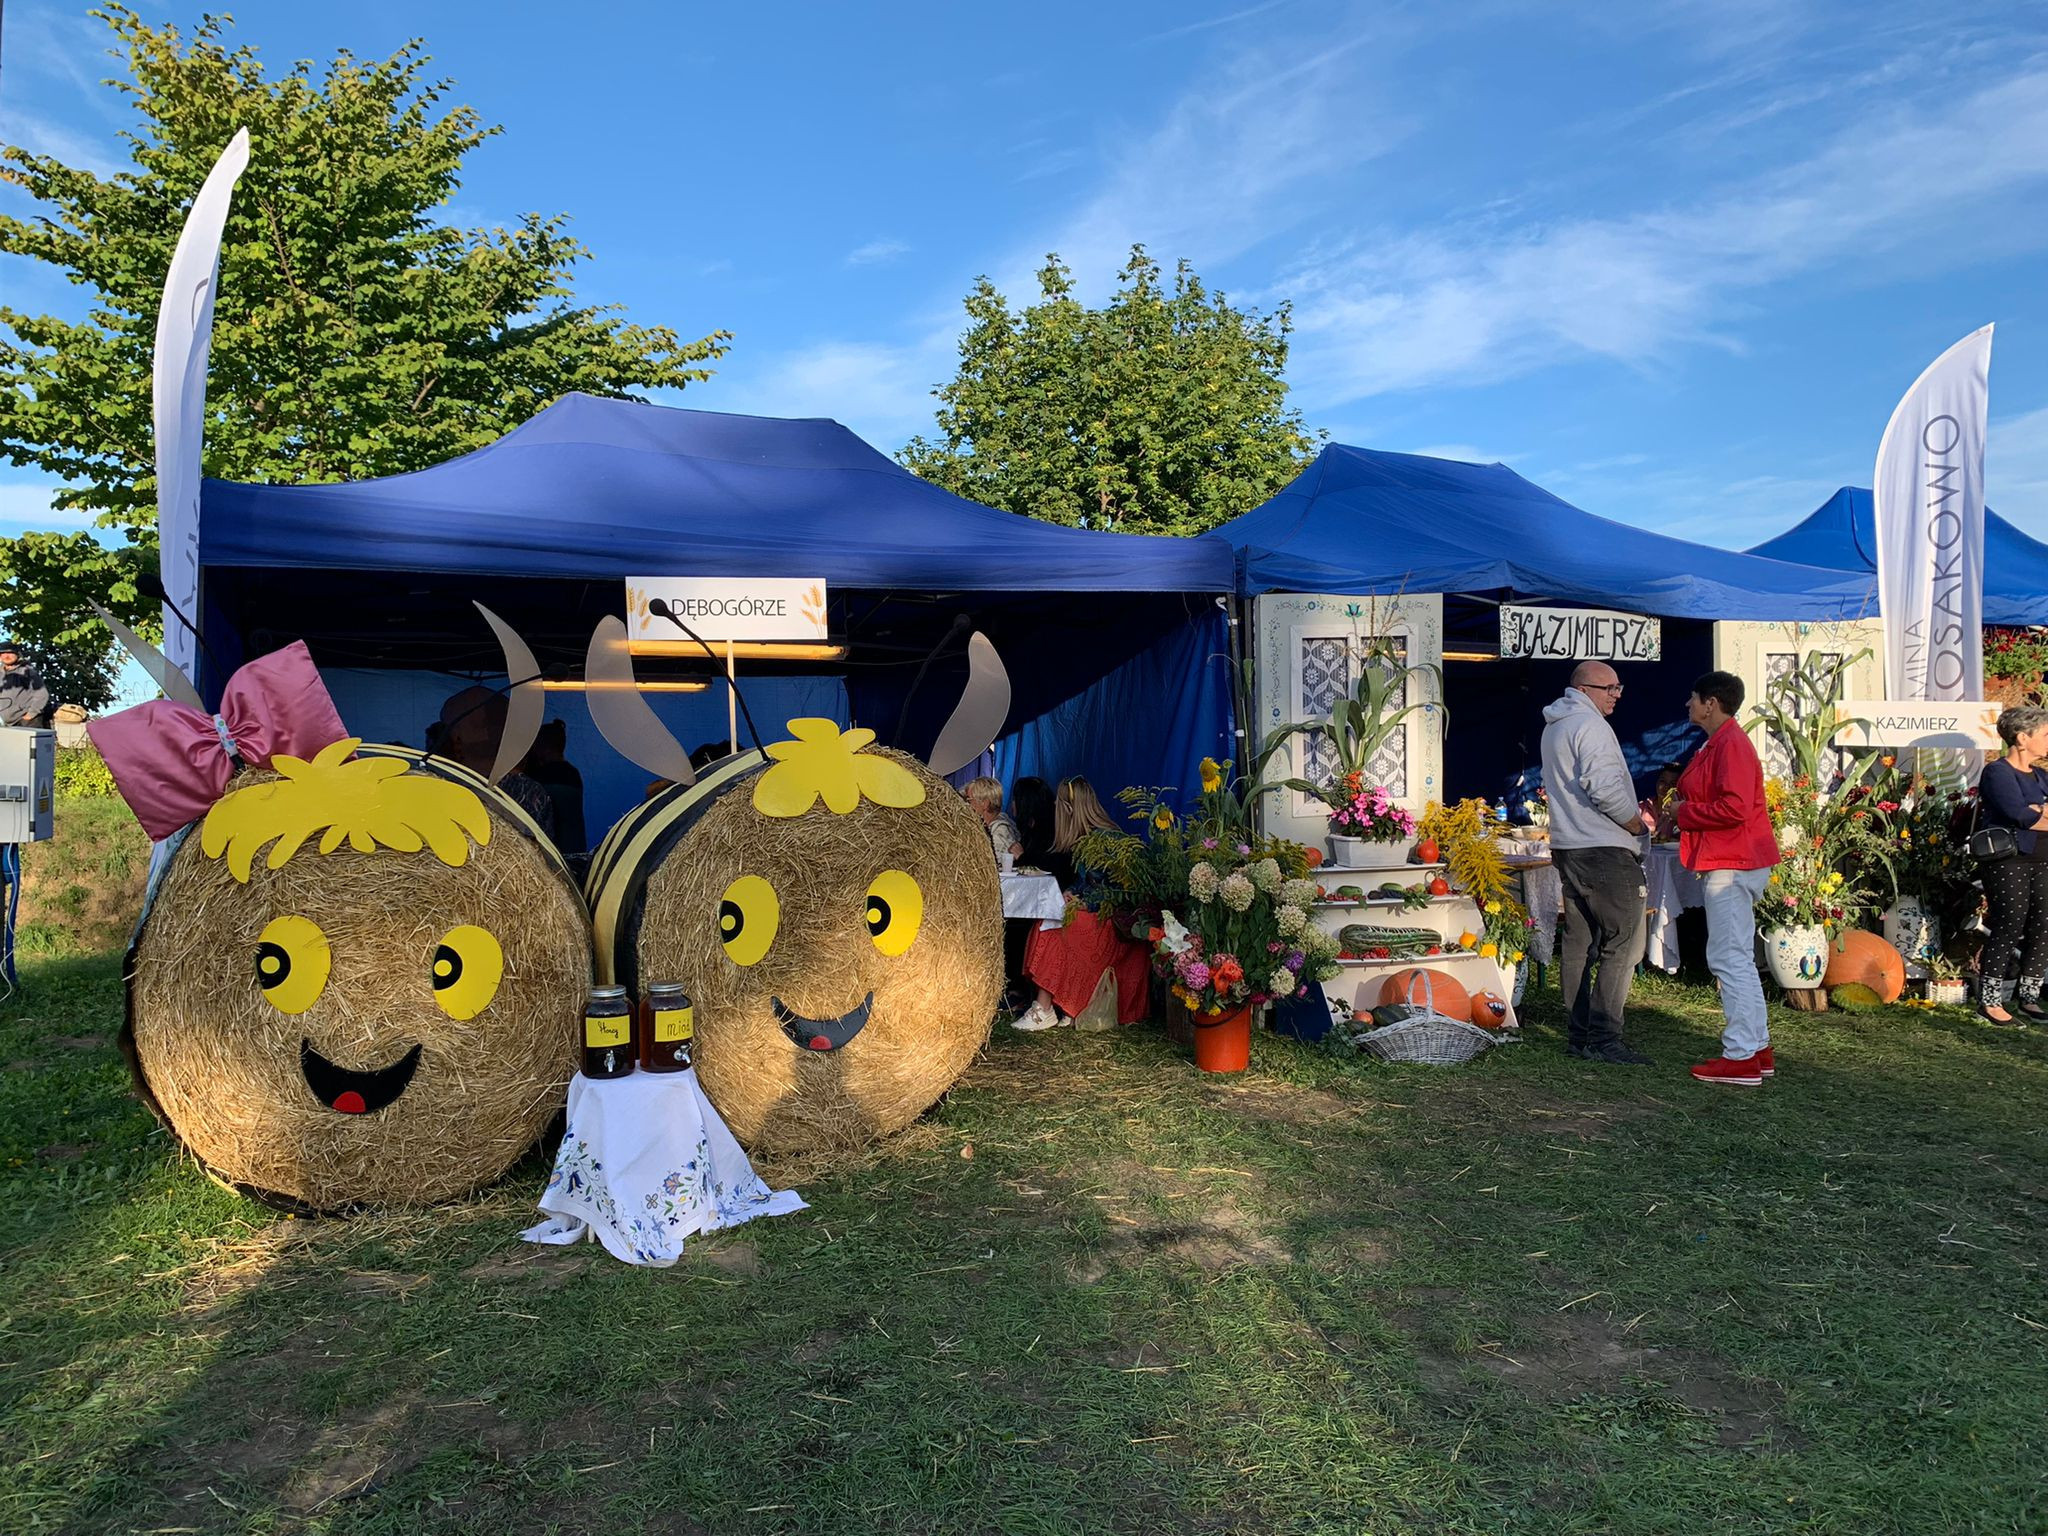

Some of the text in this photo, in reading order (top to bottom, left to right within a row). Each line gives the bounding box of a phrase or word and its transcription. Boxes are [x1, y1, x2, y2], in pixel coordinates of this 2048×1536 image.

[1923, 414, 1966, 701] OSAKOWO
[672, 595, 787, 621] DĘBOGÓRZE
[1511, 611, 1649, 660] KAZIMIERZ
[1904, 619, 1929, 698] MINA
[1876, 716, 1958, 731] KAZIMIERZ
